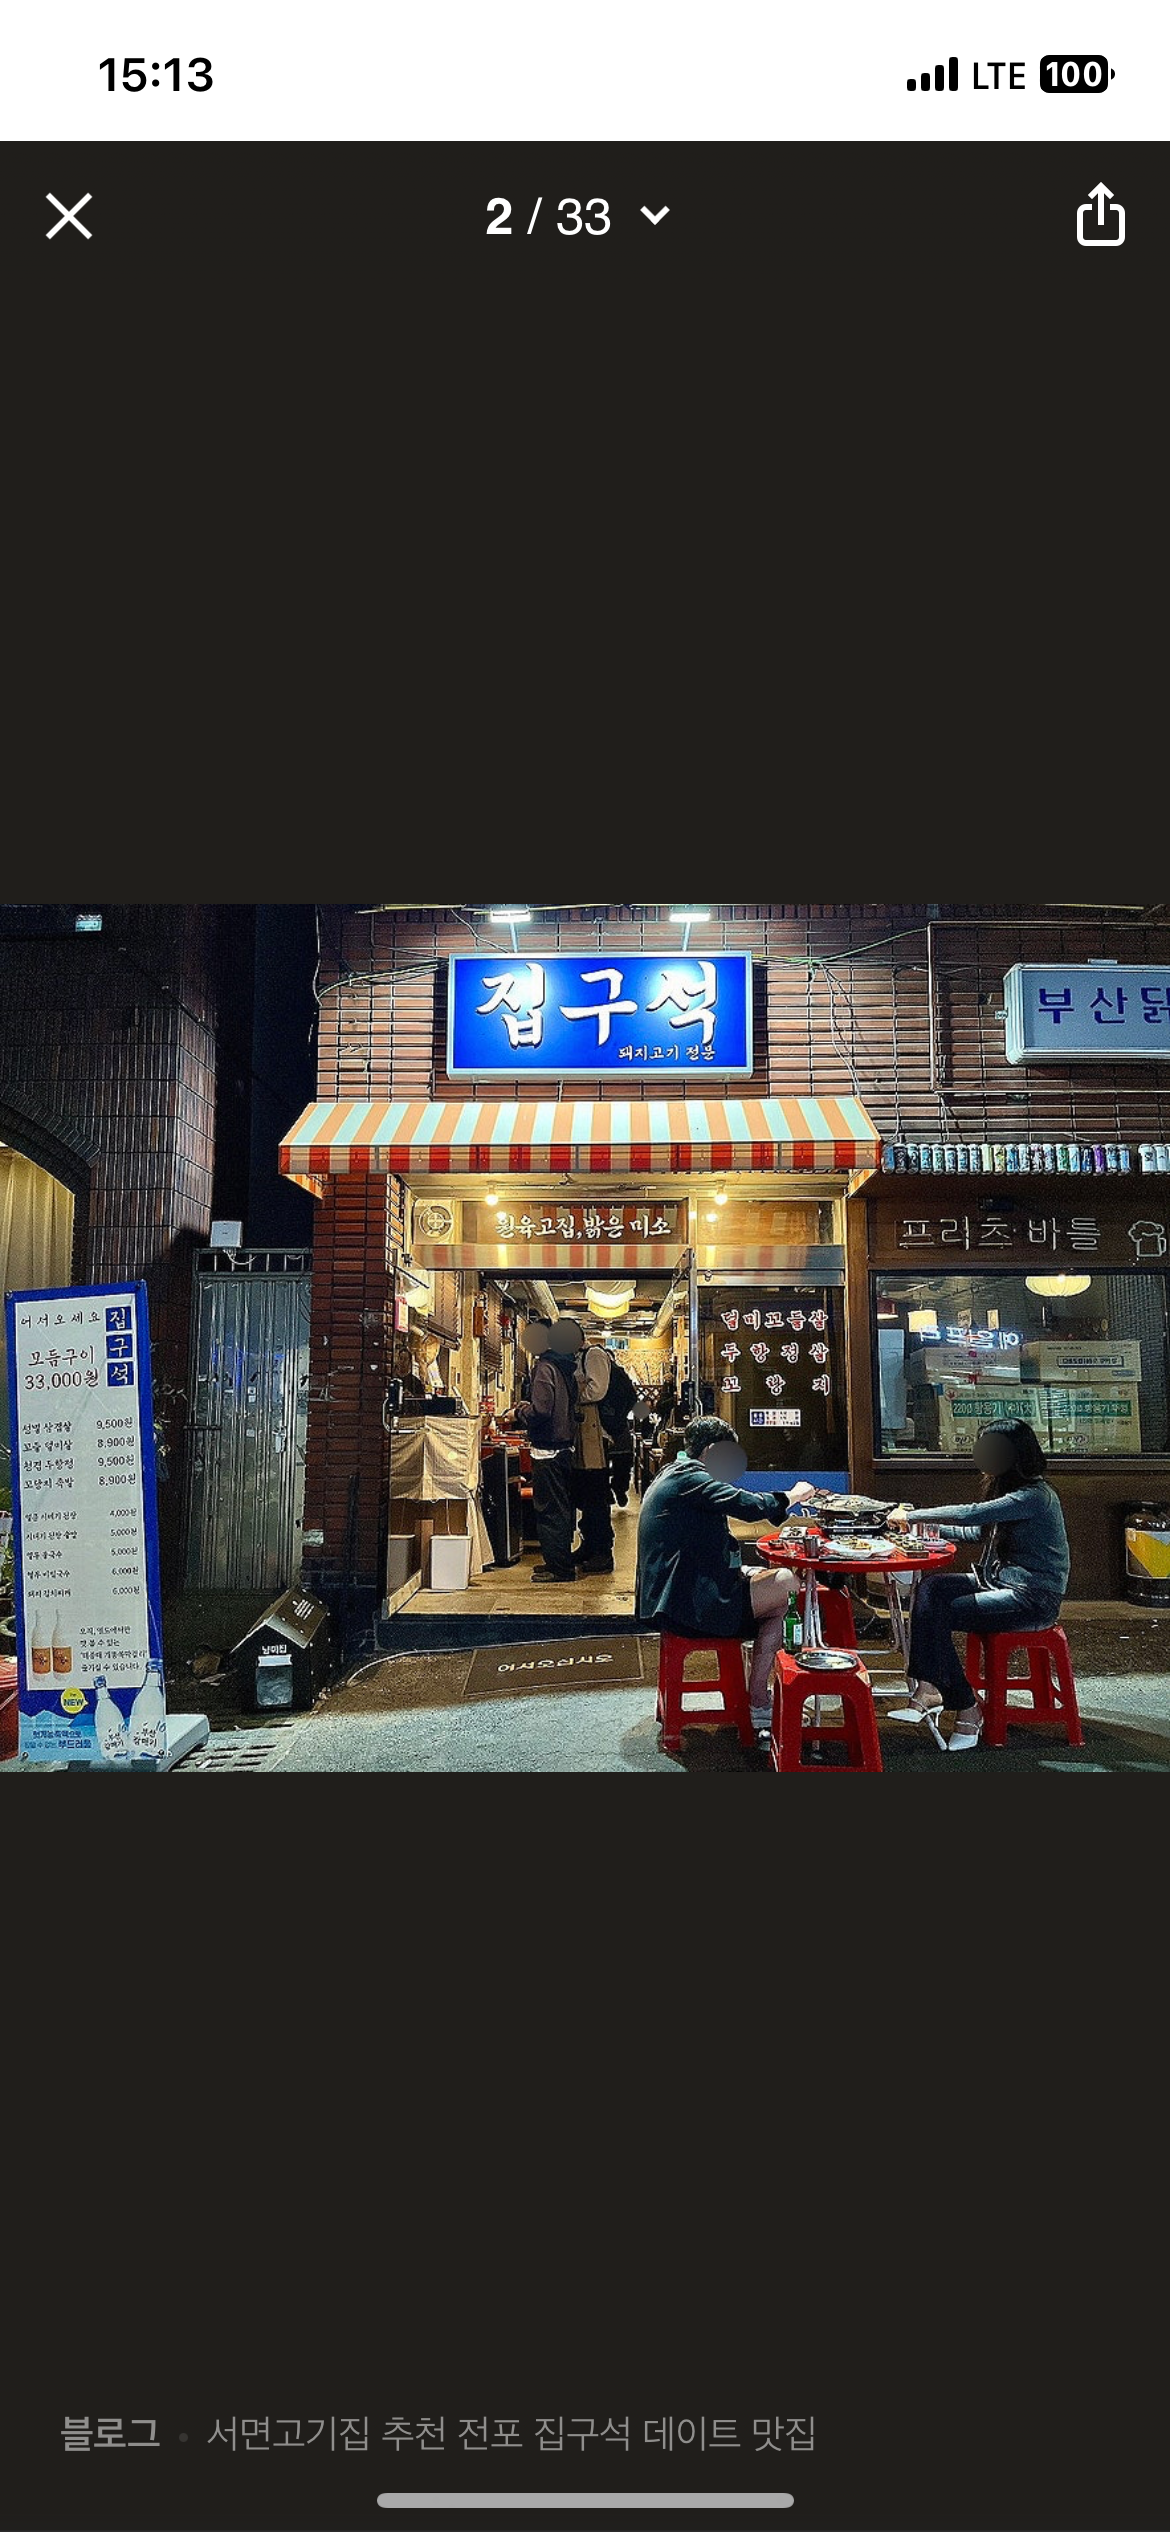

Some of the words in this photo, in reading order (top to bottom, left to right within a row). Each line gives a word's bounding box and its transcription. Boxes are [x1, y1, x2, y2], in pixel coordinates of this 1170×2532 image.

[476, 961, 718, 1050] 집구석
[618, 1045, 680, 1062] 돼지고기
[685, 1044, 716, 1062] 전문
[629, 1214, 672, 1239] 미소
[899, 1216, 1013, 1249] 프리츠
[1028, 1216, 1101, 1250] 바틀
[109, 1308, 131, 1385] 집구석
[28, 1345, 95, 1368] 모듬구이
[24, 1368, 100, 1391] 33,000원
[96, 1417, 133, 1430] 9,500원
[97, 1436, 135, 1448] 8,900원
[97, 1454, 135, 1467] 9,500원
[98, 1473, 136, 1486] 8,900원
[109, 1508, 137, 1517] 4,000원
[110, 1528, 137, 1537] 5,000원
[58, 1739, 91, 1749] 부드러움
